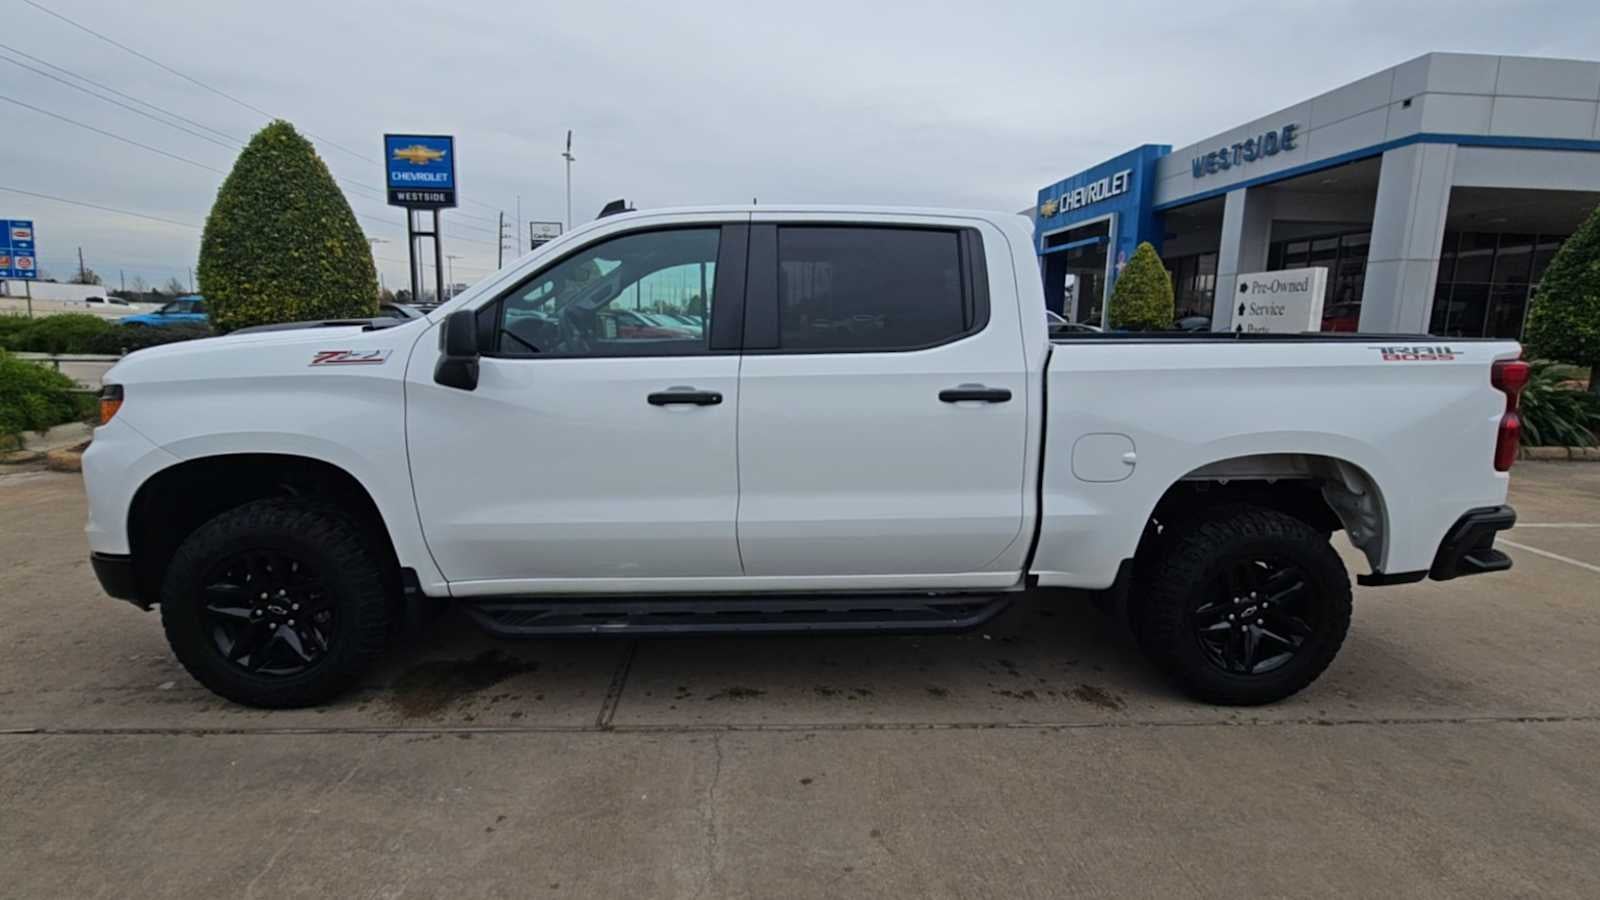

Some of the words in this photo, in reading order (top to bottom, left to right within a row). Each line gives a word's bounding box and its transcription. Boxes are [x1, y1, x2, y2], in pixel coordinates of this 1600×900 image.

[1192, 123, 1299, 178] WESTSIDE
[392, 171, 448, 182] CHEVROLET
[397, 192, 446, 202] WESTSIDE
[1058, 168, 1132, 213] CHEVROLET
[1251, 277, 1309, 294] Pre-Owned
[1249, 302, 1285, 316] Service
[1368, 346, 1464, 354] TRAIL
